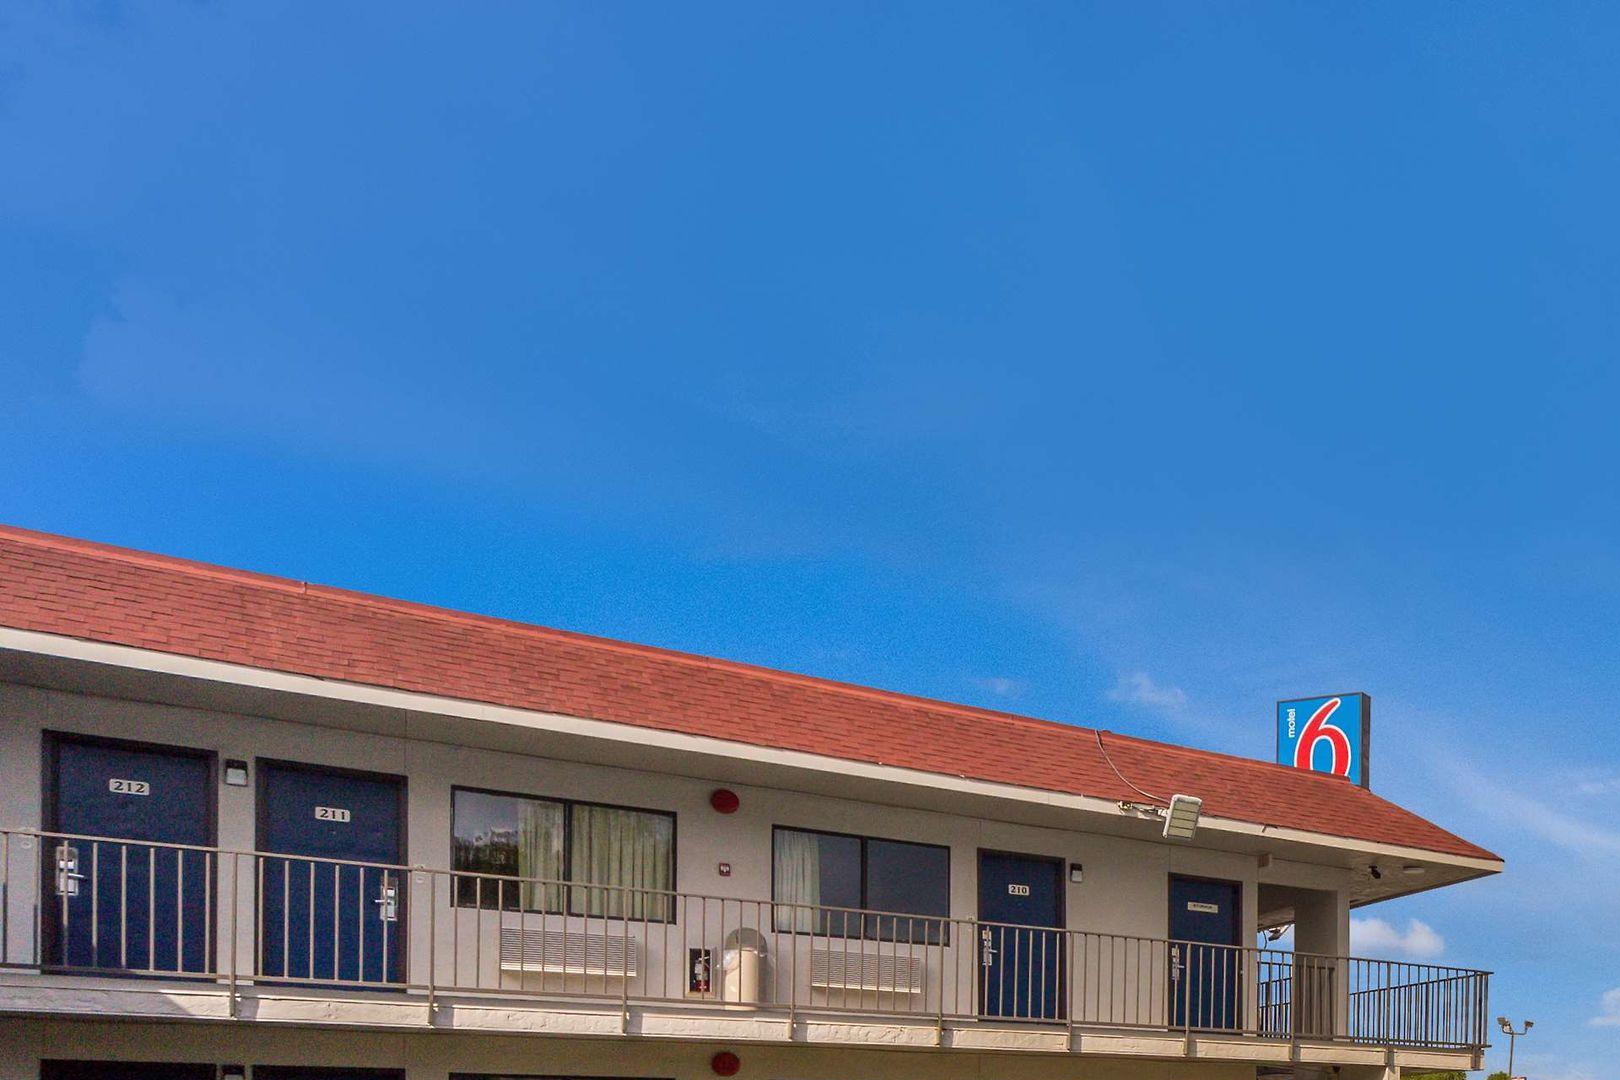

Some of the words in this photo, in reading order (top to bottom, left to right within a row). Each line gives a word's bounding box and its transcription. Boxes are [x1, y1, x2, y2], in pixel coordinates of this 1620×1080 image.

[1286, 708, 1296, 738] motel
[1294, 697, 1352, 777] 6
[113, 780, 146, 794] 212
[319, 808, 346, 820] 211
[1010, 885, 1028, 895] 210
